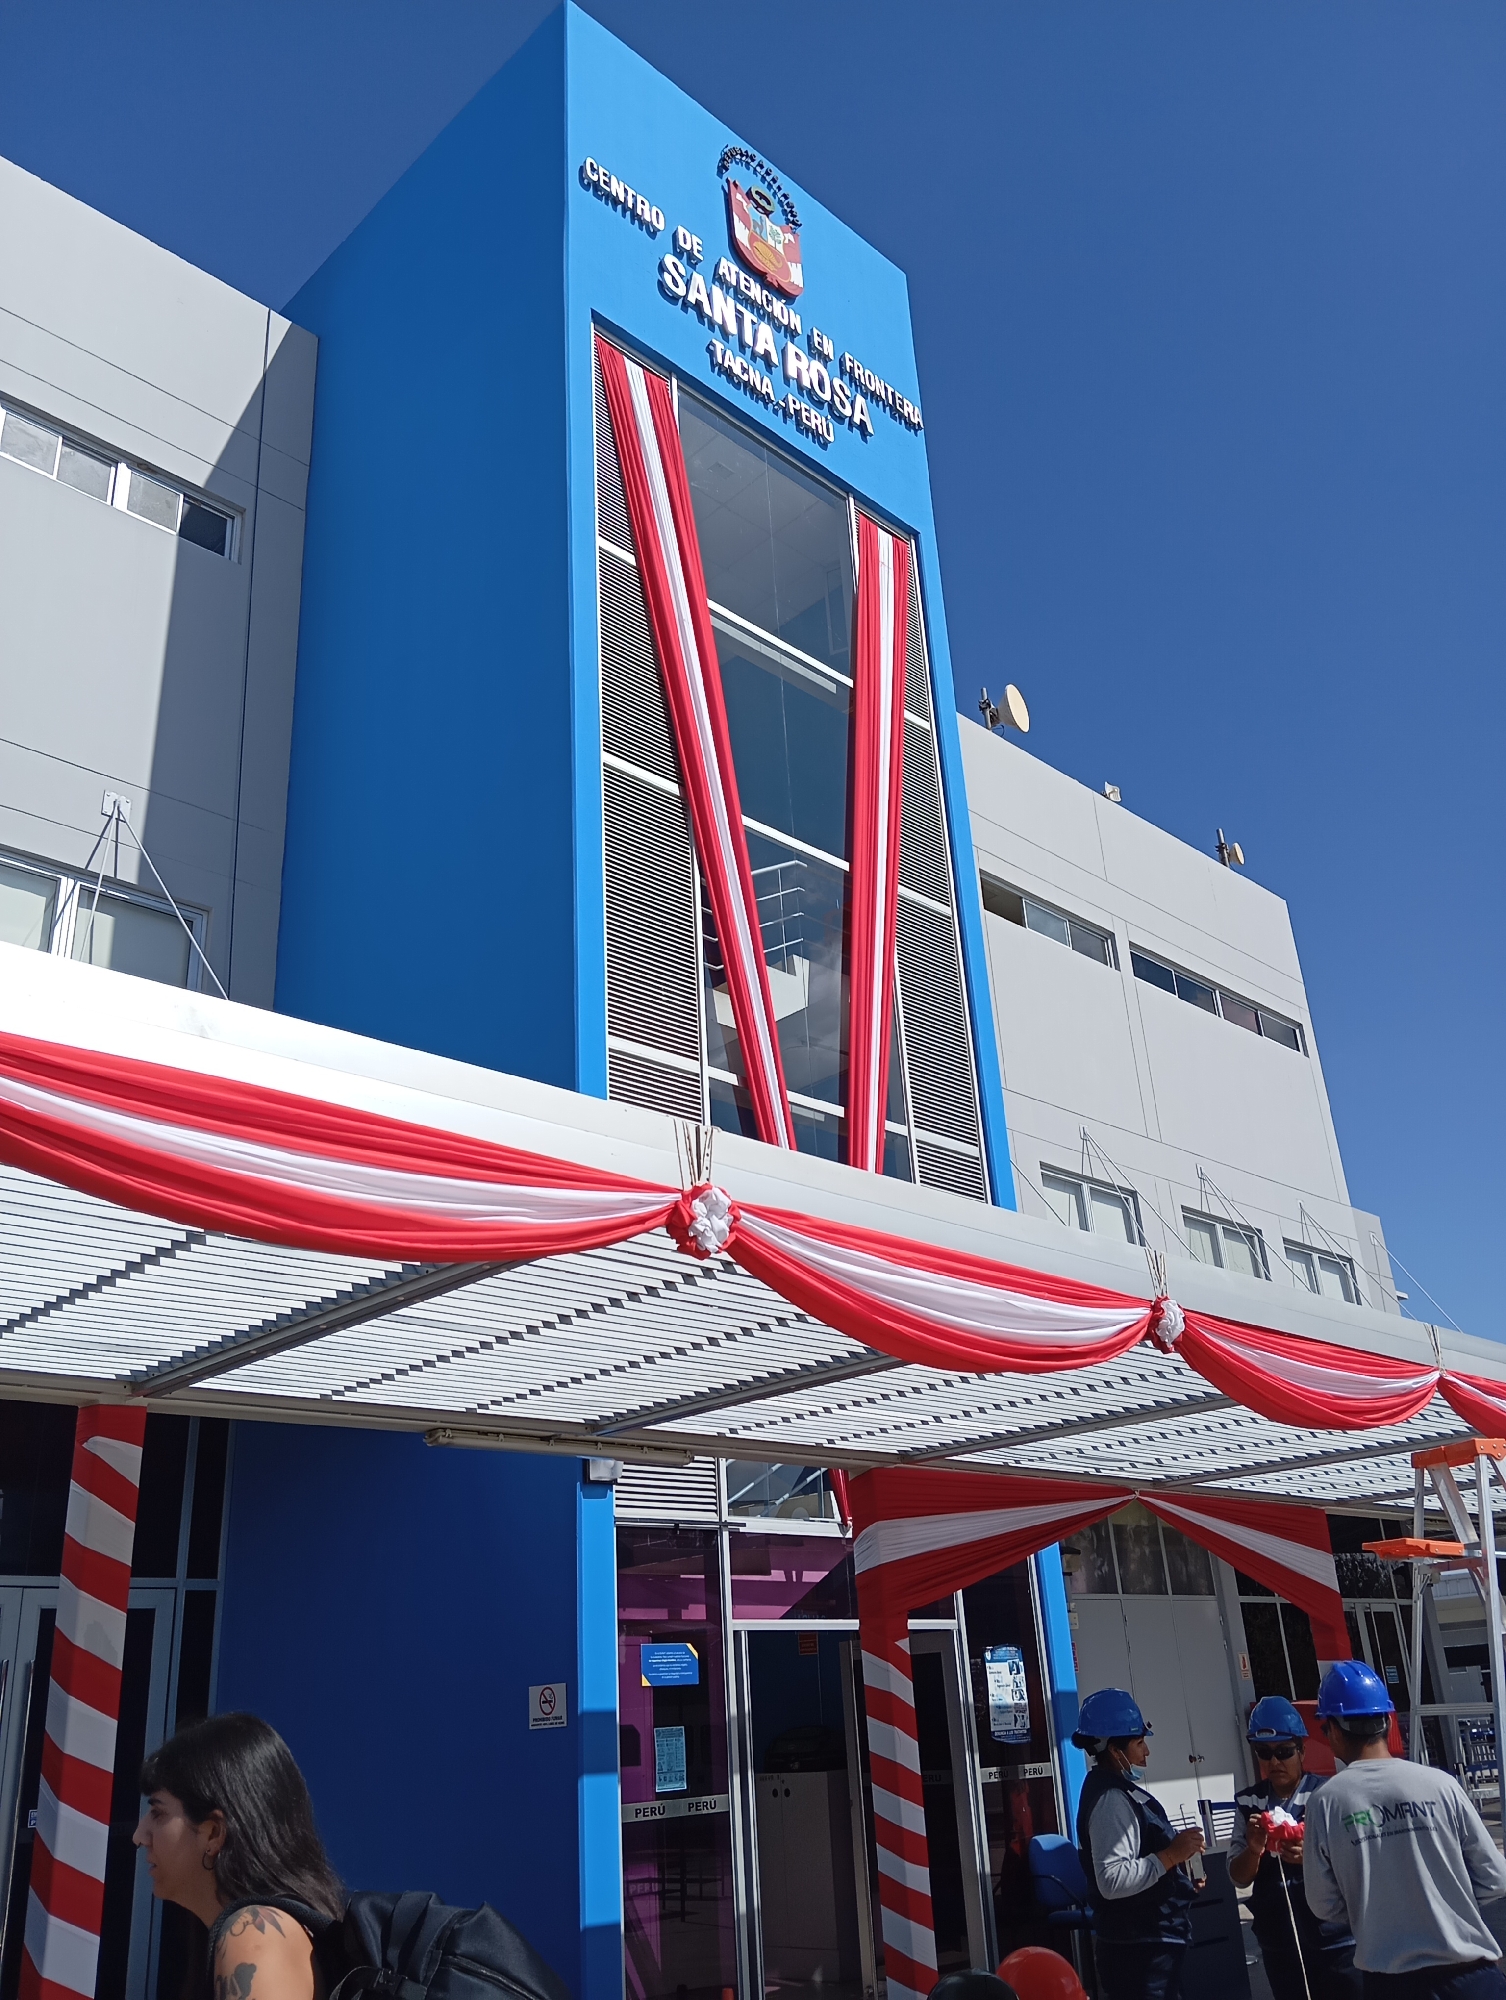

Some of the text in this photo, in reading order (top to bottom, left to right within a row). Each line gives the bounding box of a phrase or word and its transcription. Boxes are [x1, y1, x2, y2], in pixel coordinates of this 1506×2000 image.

[584, 156, 924, 430] CENTRO DE ATENCIÓN EN FRONTERA
[662, 253, 875, 437] SANTA ROSA
[711, 338, 776, 402] TACNA
[787, 392, 835, 443] PERÚ
[1024, 1765, 1044, 1777] PERÚ
[634, 1798, 717, 1819] PERÚ PERÚ
[1341, 1802, 1436, 1832] PROMANT
